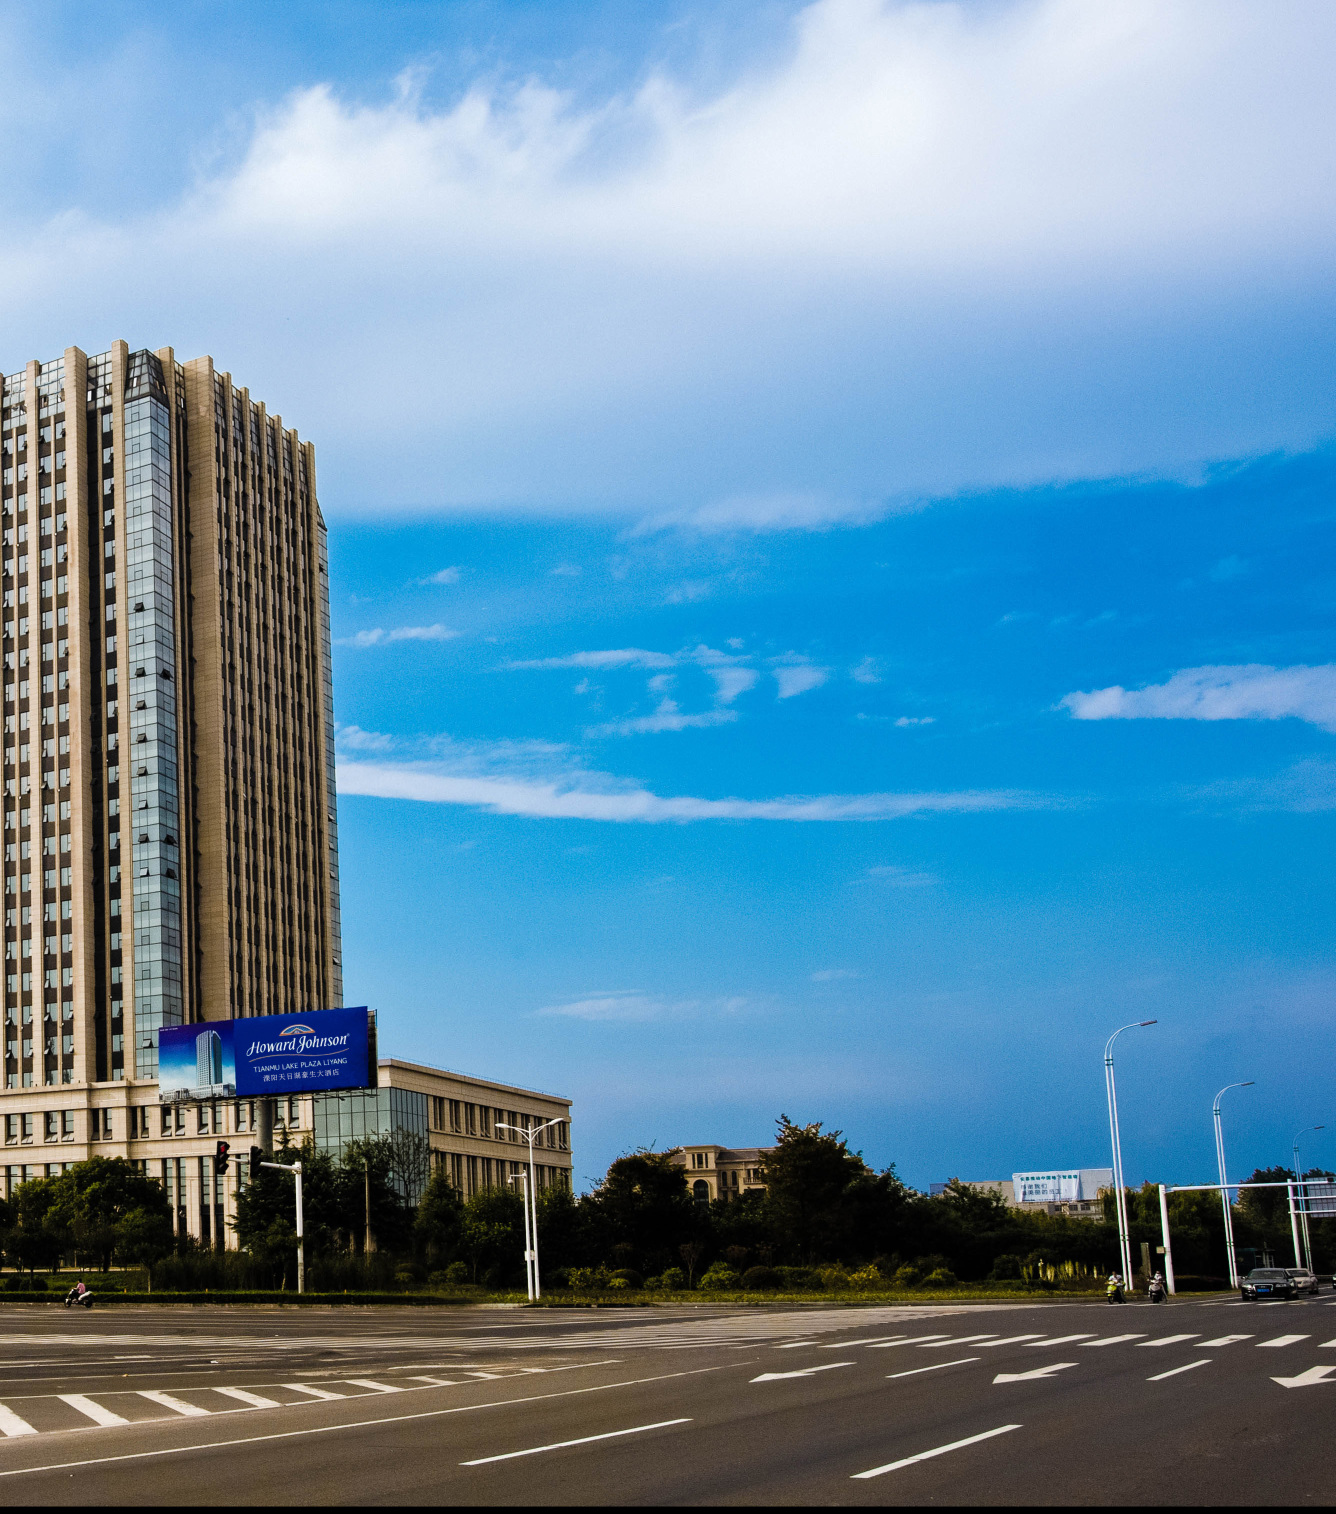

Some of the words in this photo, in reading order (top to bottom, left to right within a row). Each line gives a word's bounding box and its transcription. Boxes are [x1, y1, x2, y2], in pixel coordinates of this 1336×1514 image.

[246, 1038, 296, 1056] Howard
[297, 1035, 347, 1052] Johnson
[253, 1064, 280, 1073] TIANMU
[282, 1062, 299, 1070] LAKE
[300, 1060, 322, 1068] PLAZA
[323, 1057, 348, 1066] LIYANG
